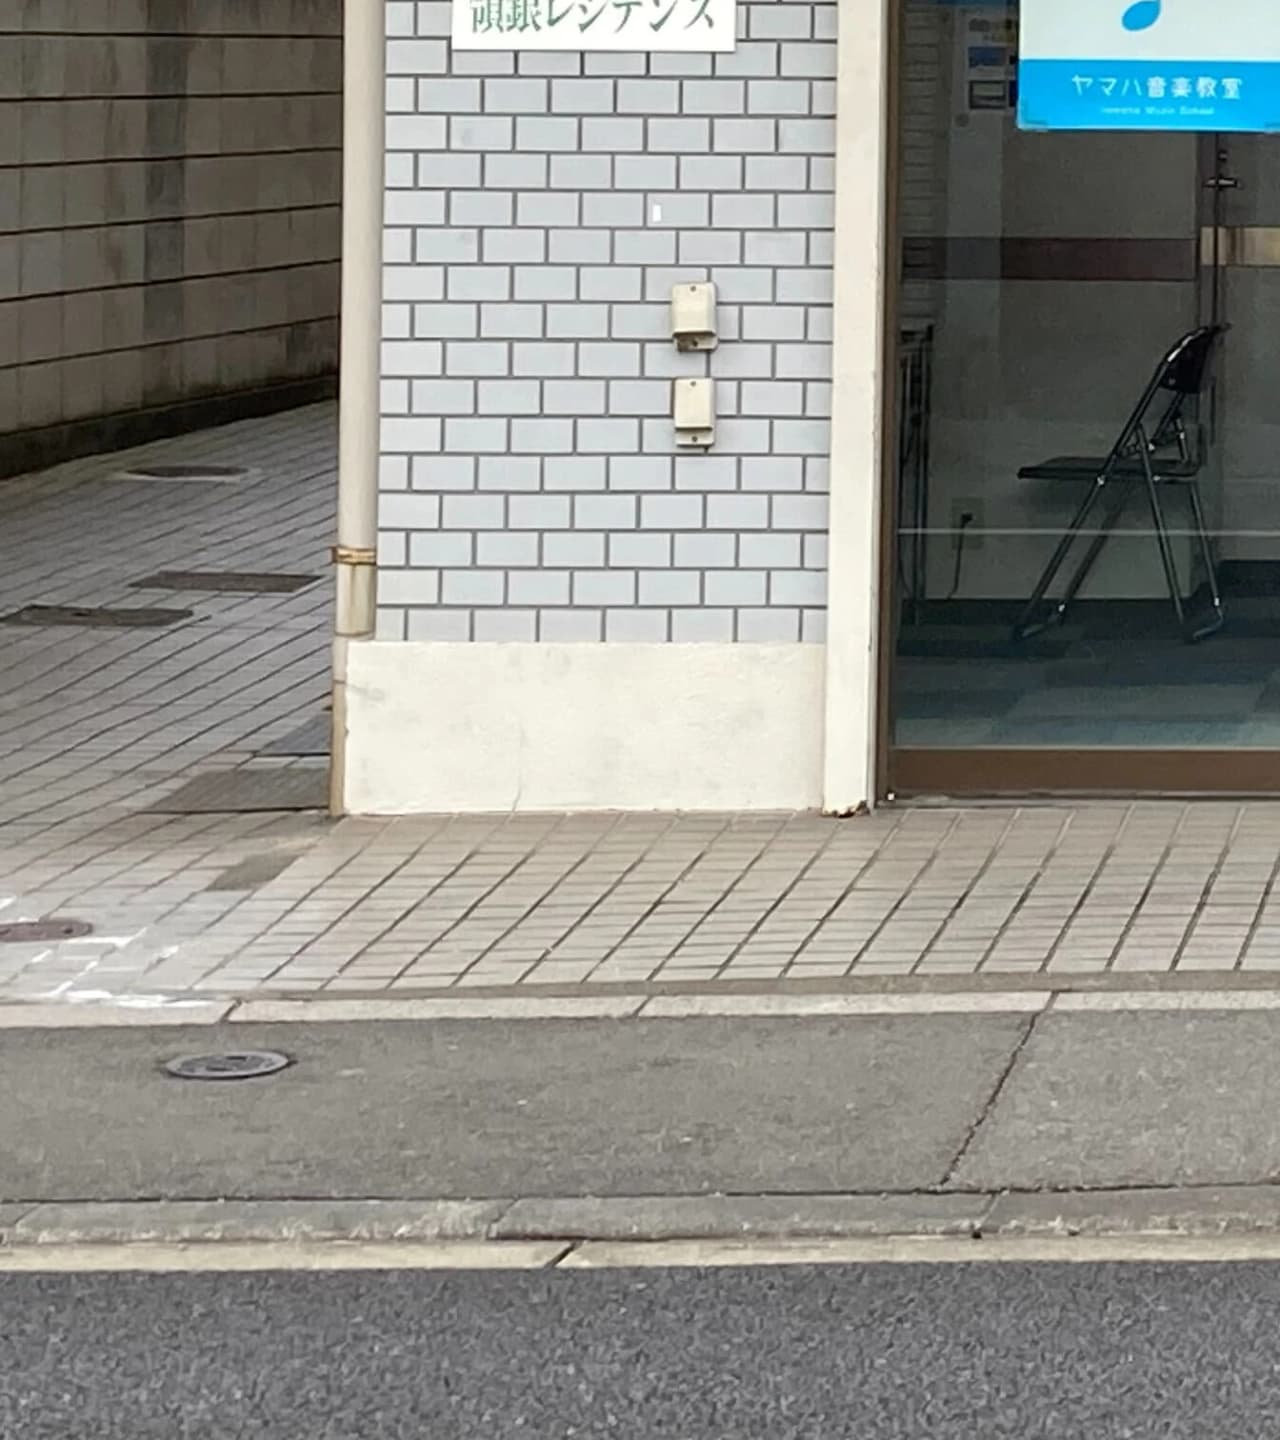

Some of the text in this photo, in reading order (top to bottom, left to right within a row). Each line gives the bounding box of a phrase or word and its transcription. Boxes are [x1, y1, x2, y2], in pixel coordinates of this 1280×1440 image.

[1071, 74, 1243, 99] ヤマハ音楽教室
